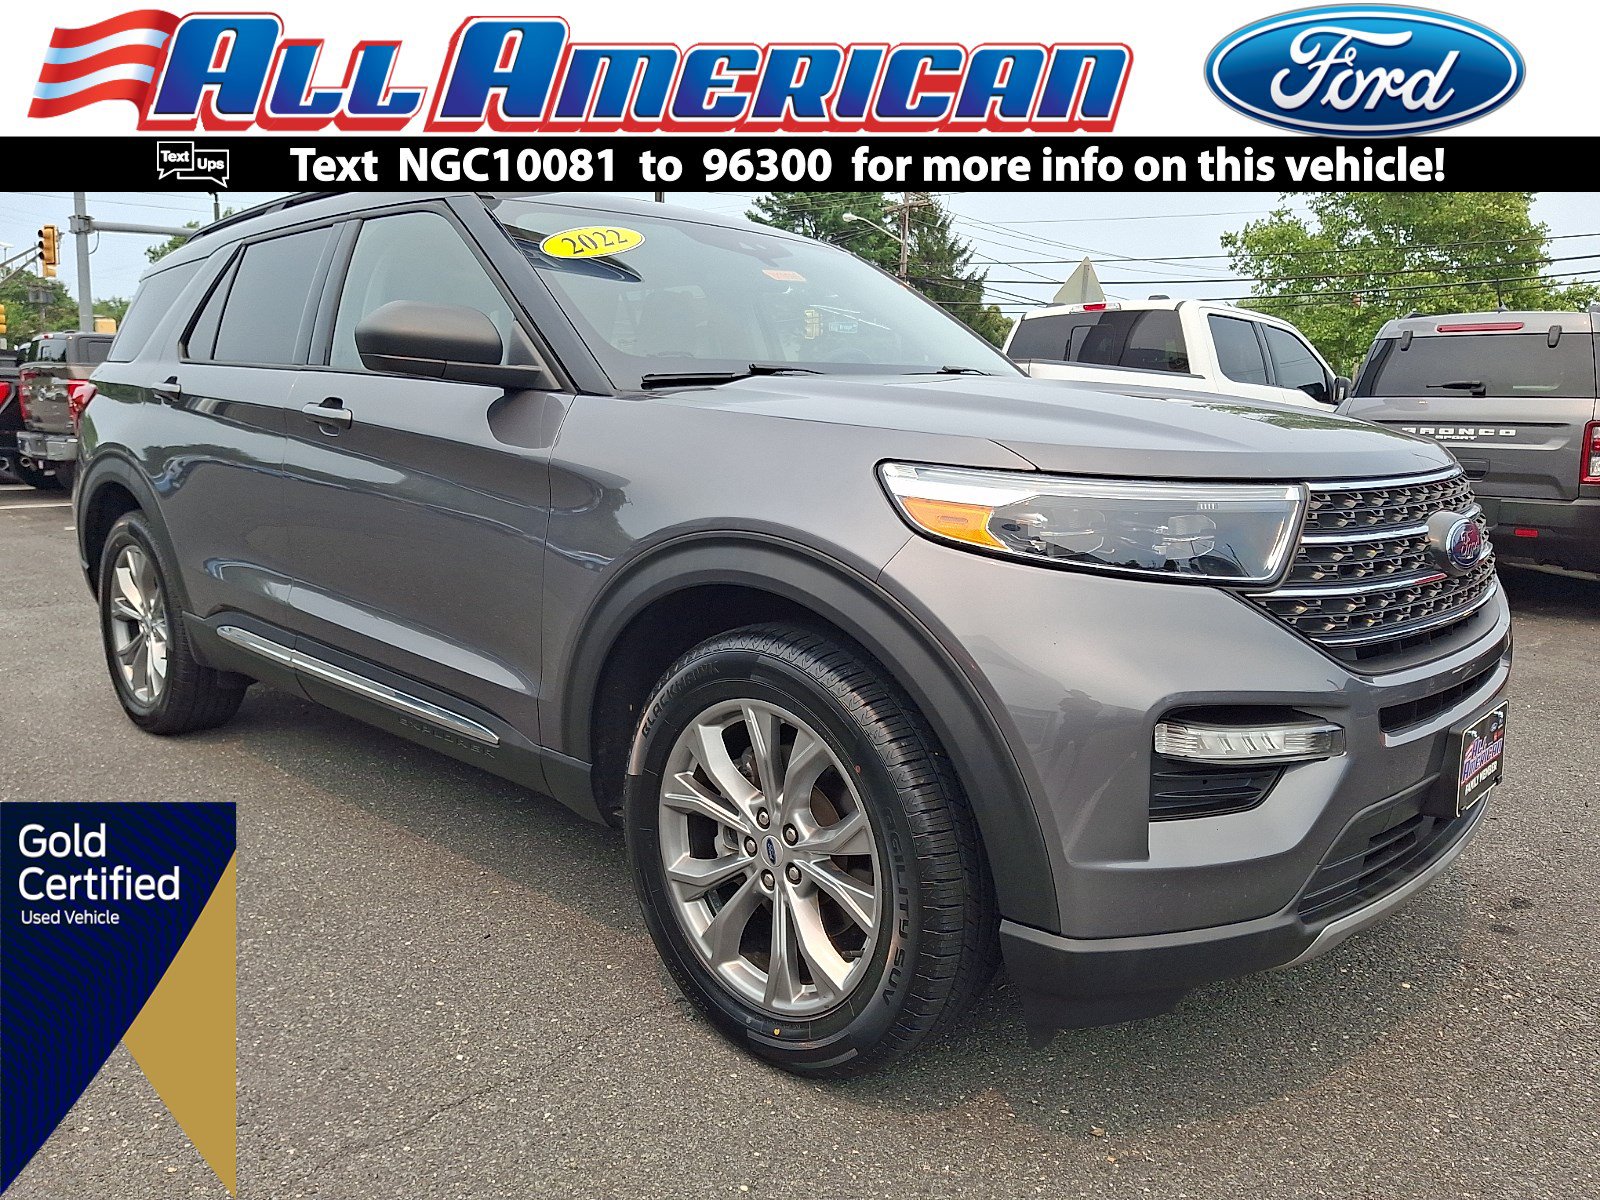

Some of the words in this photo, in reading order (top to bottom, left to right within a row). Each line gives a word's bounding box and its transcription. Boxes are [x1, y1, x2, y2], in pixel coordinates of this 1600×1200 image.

[561, 229, 628, 255] 2022
[883, 806, 909, 939] AGILITY
[882, 946, 906, 1006] SUV
